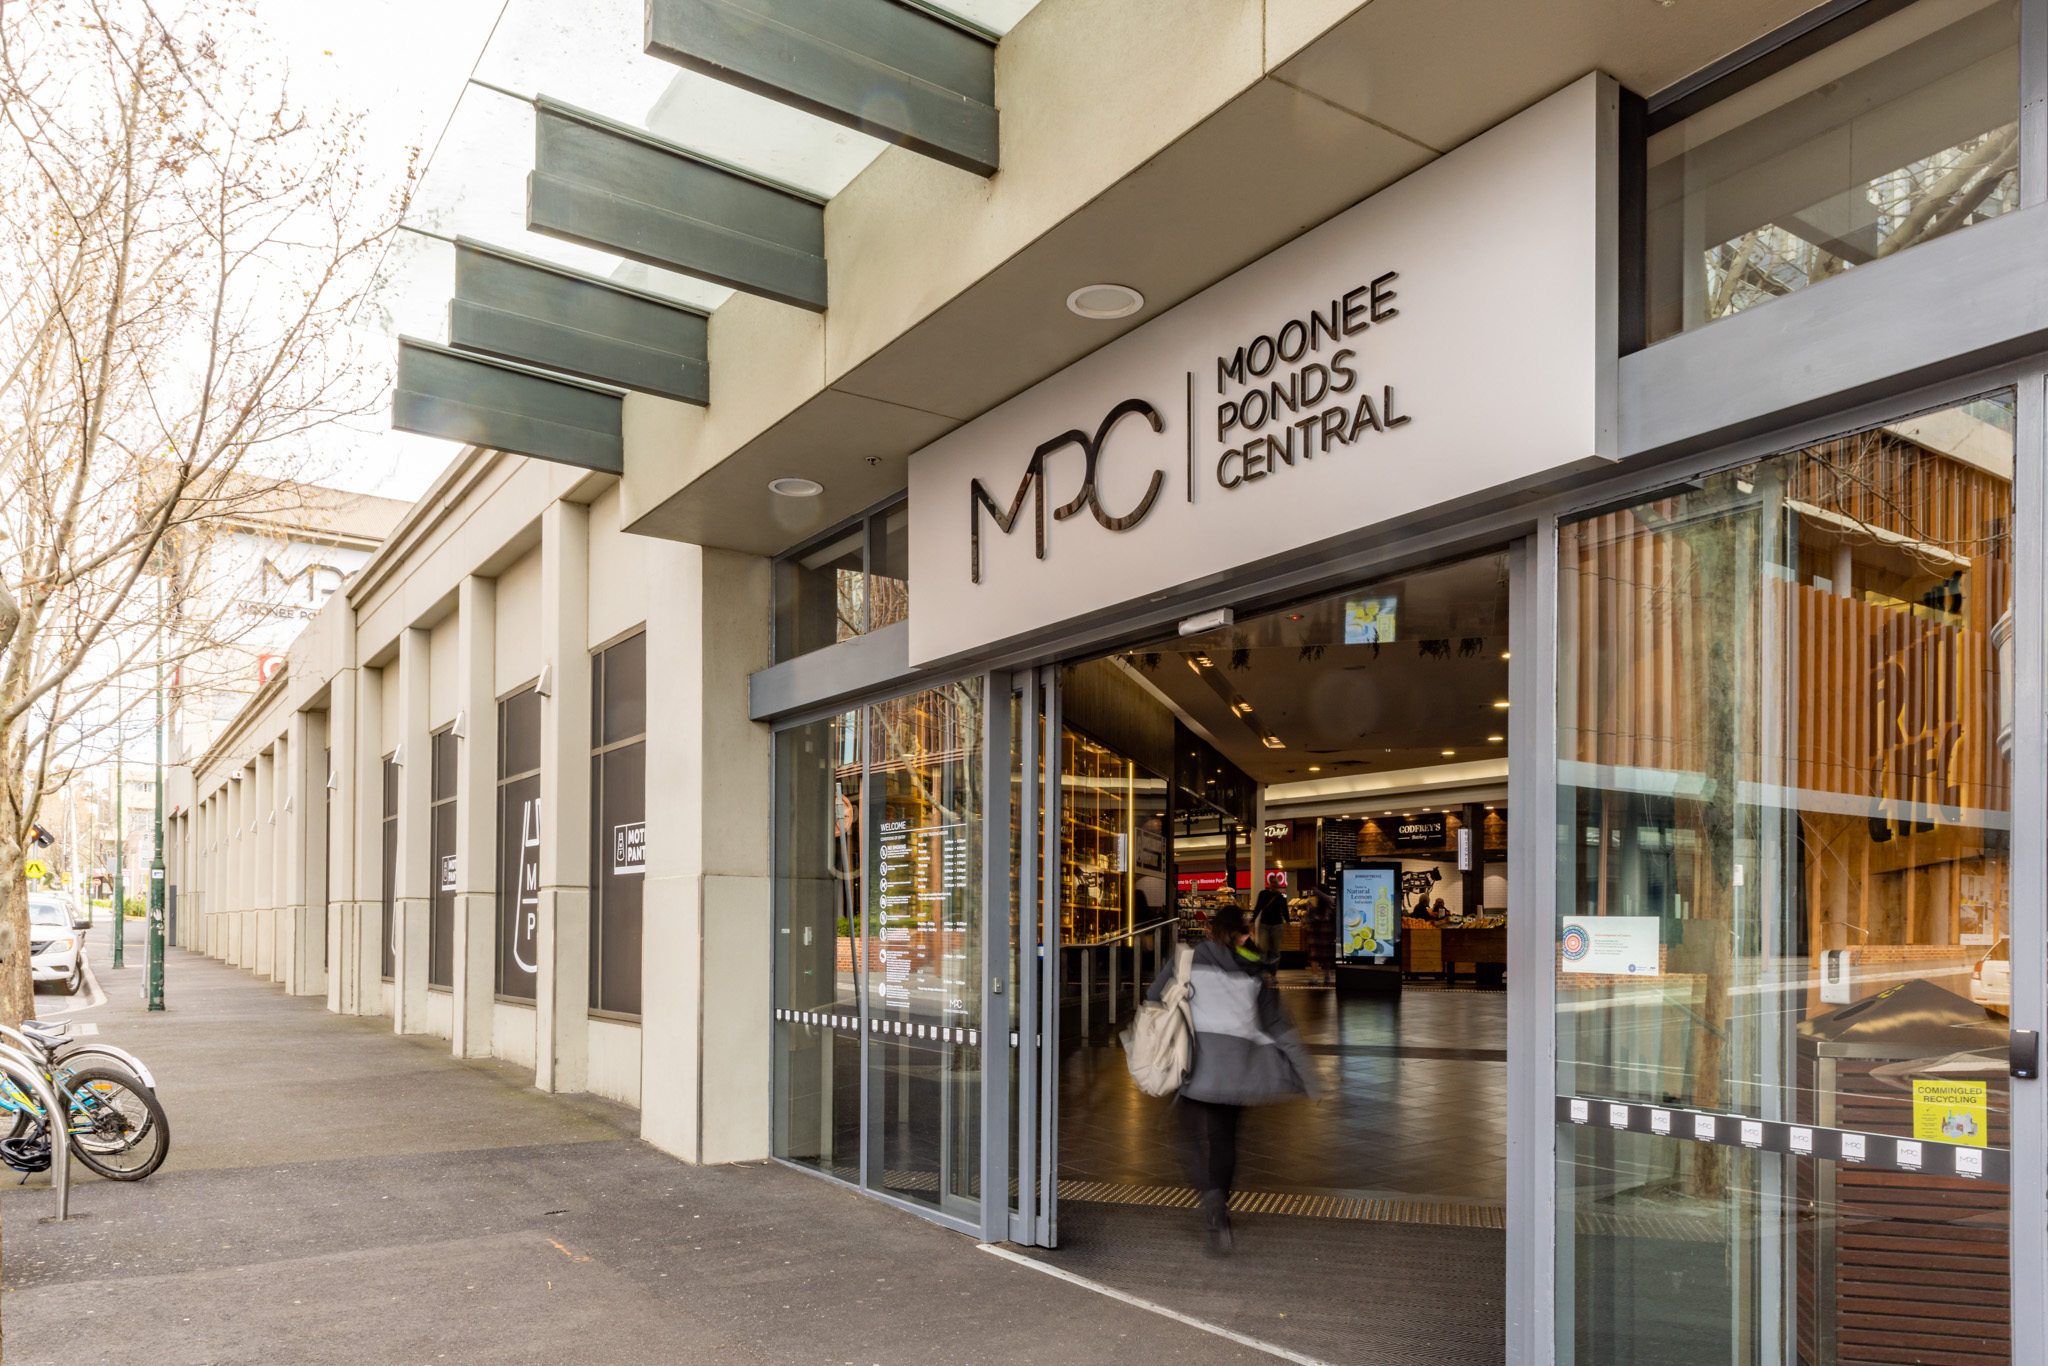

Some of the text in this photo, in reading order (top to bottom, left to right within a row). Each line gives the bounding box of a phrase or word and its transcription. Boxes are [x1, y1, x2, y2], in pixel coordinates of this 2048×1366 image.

[1217, 270, 1400, 395] MOONEE
[1217, 348, 1358, 443] PONDS
[1216, 385, 1411, 490] CENTRAL
[971, 398, 1167, 585] MPC
[262, 557, 360, 602] MP
[628, 828, 646, 845] MOT
[880, 821, 906, 832] WELCOME
[1398, 823, 1441, 834] GODFREY'S
[1917, 1086, 1983, 1095] COMMINGLED
[1923, 1095, 1977, 1104] RECYCLING
